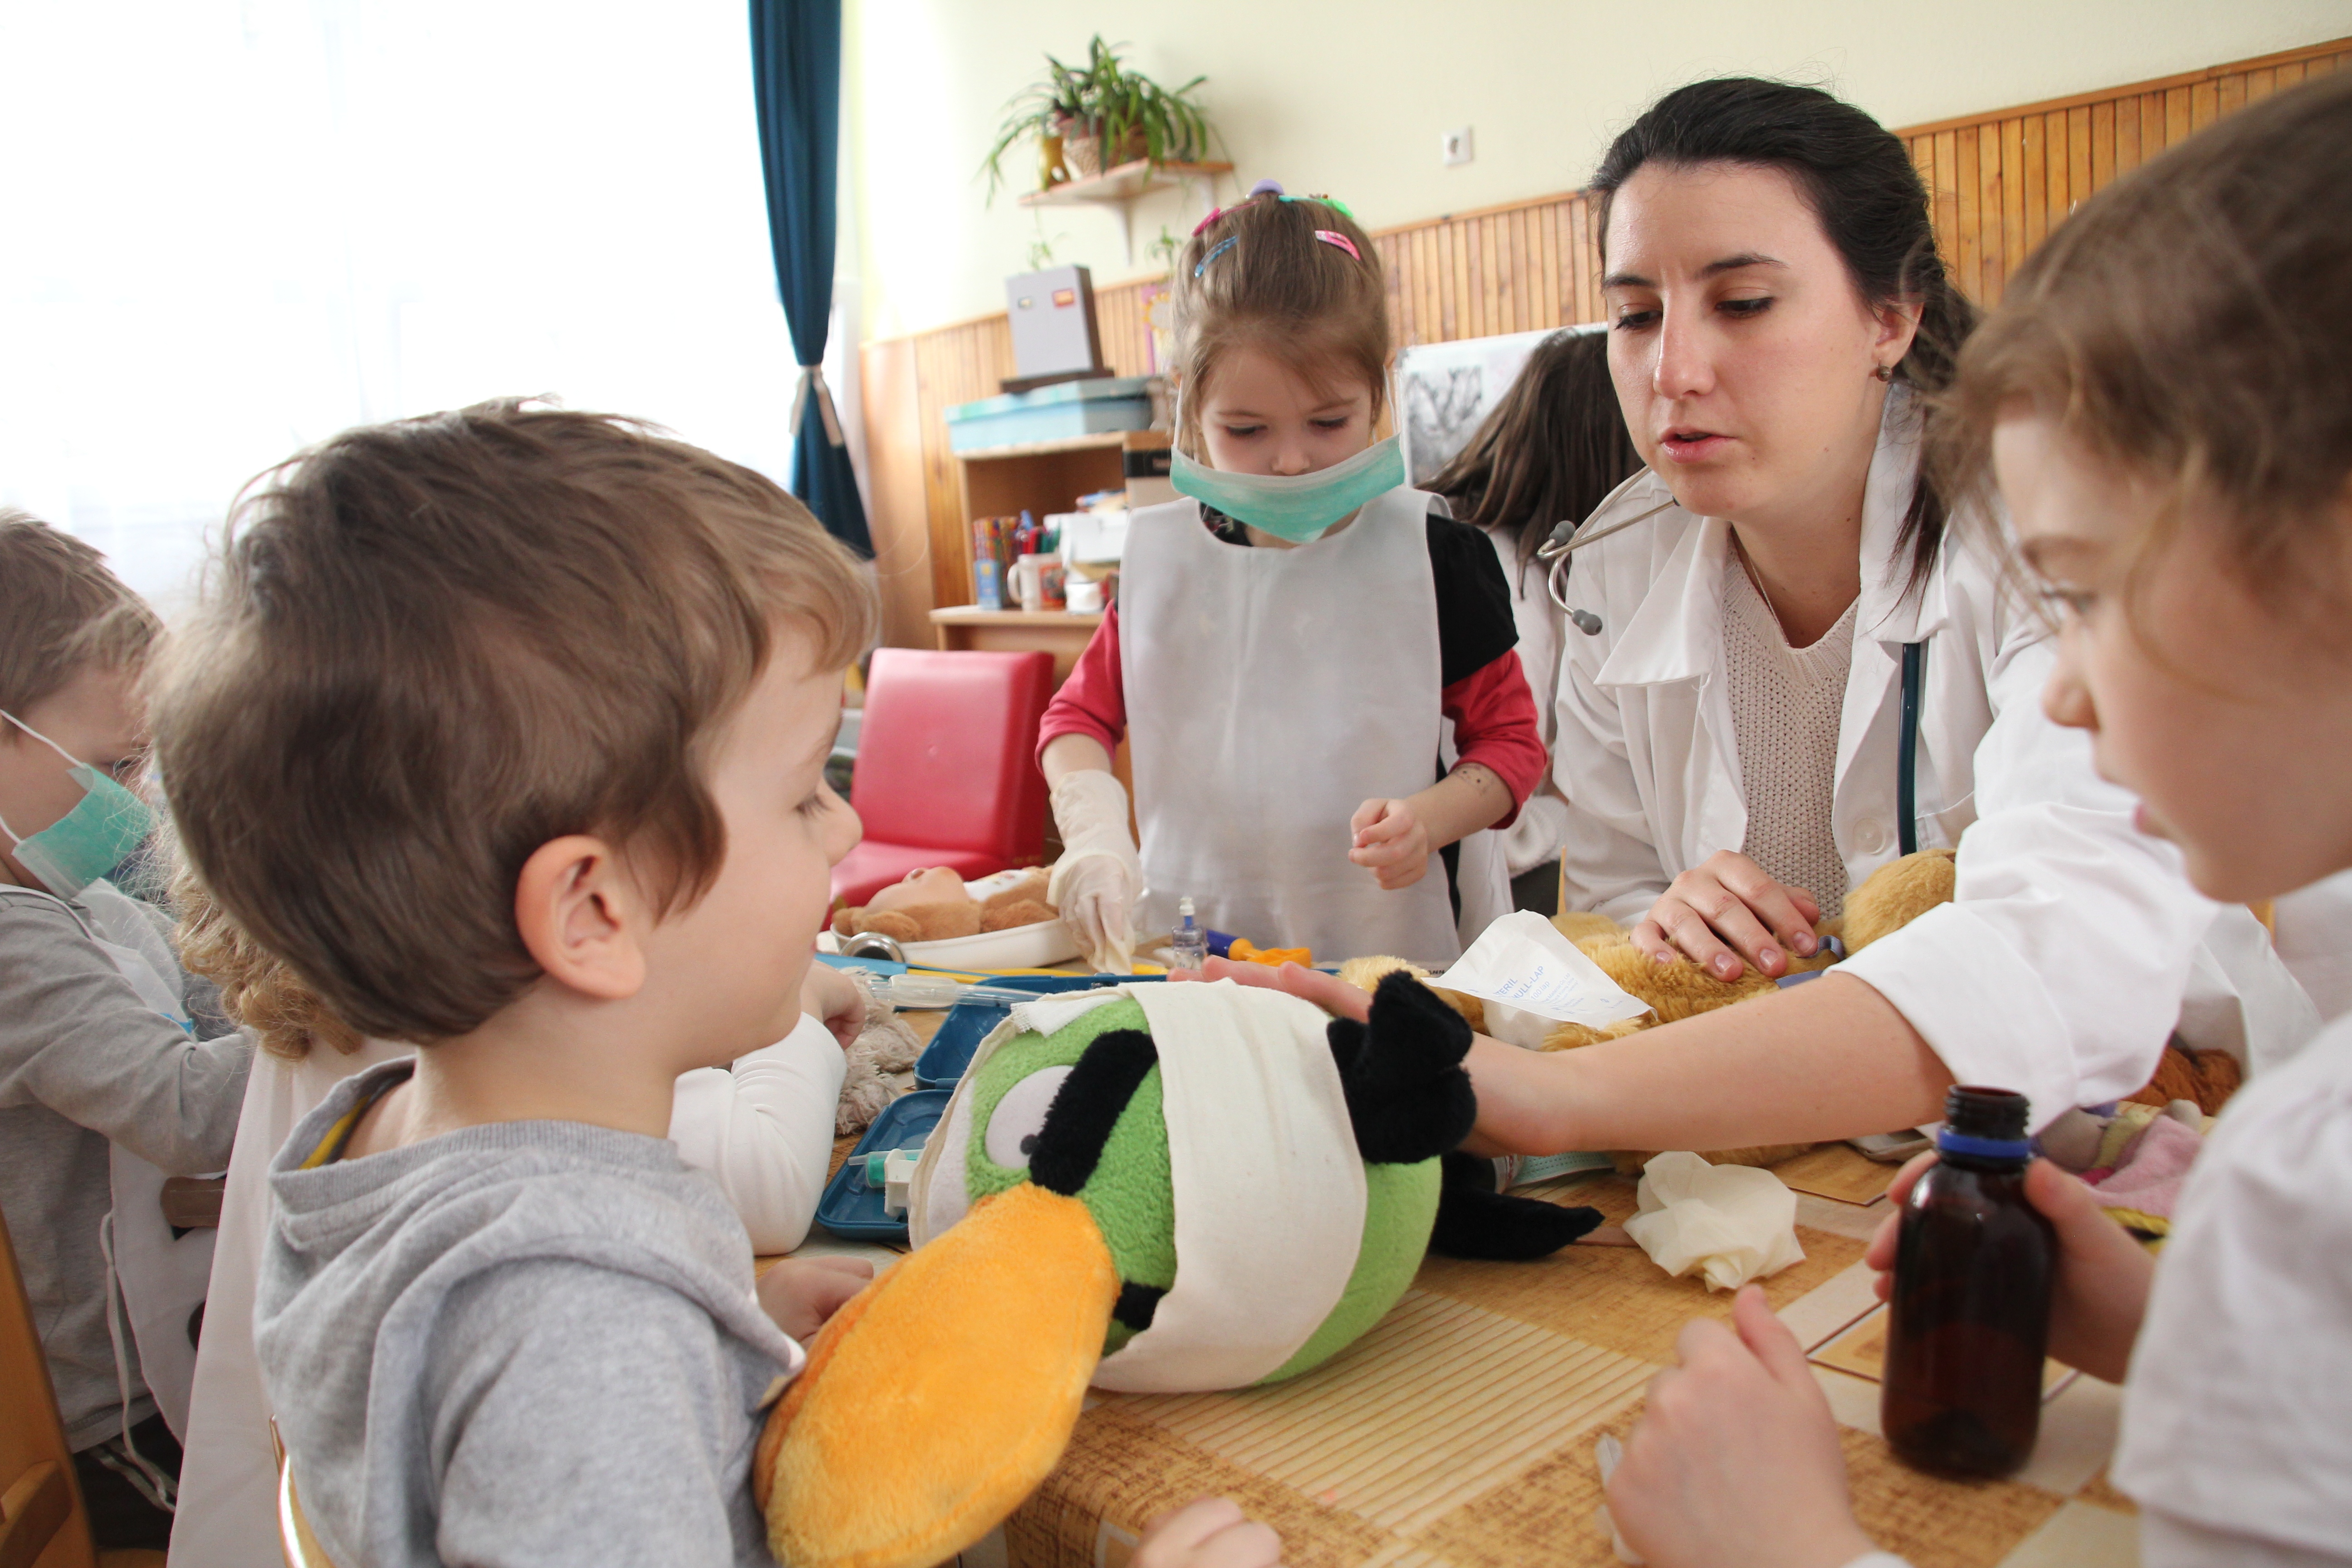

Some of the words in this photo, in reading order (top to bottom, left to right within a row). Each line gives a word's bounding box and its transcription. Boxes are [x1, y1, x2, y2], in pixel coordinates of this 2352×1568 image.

[1494, 978, 1518, 995] TERIL
[1531, 989, 1542, 1000] 100
[1540, 981, 1550, 991] lap
